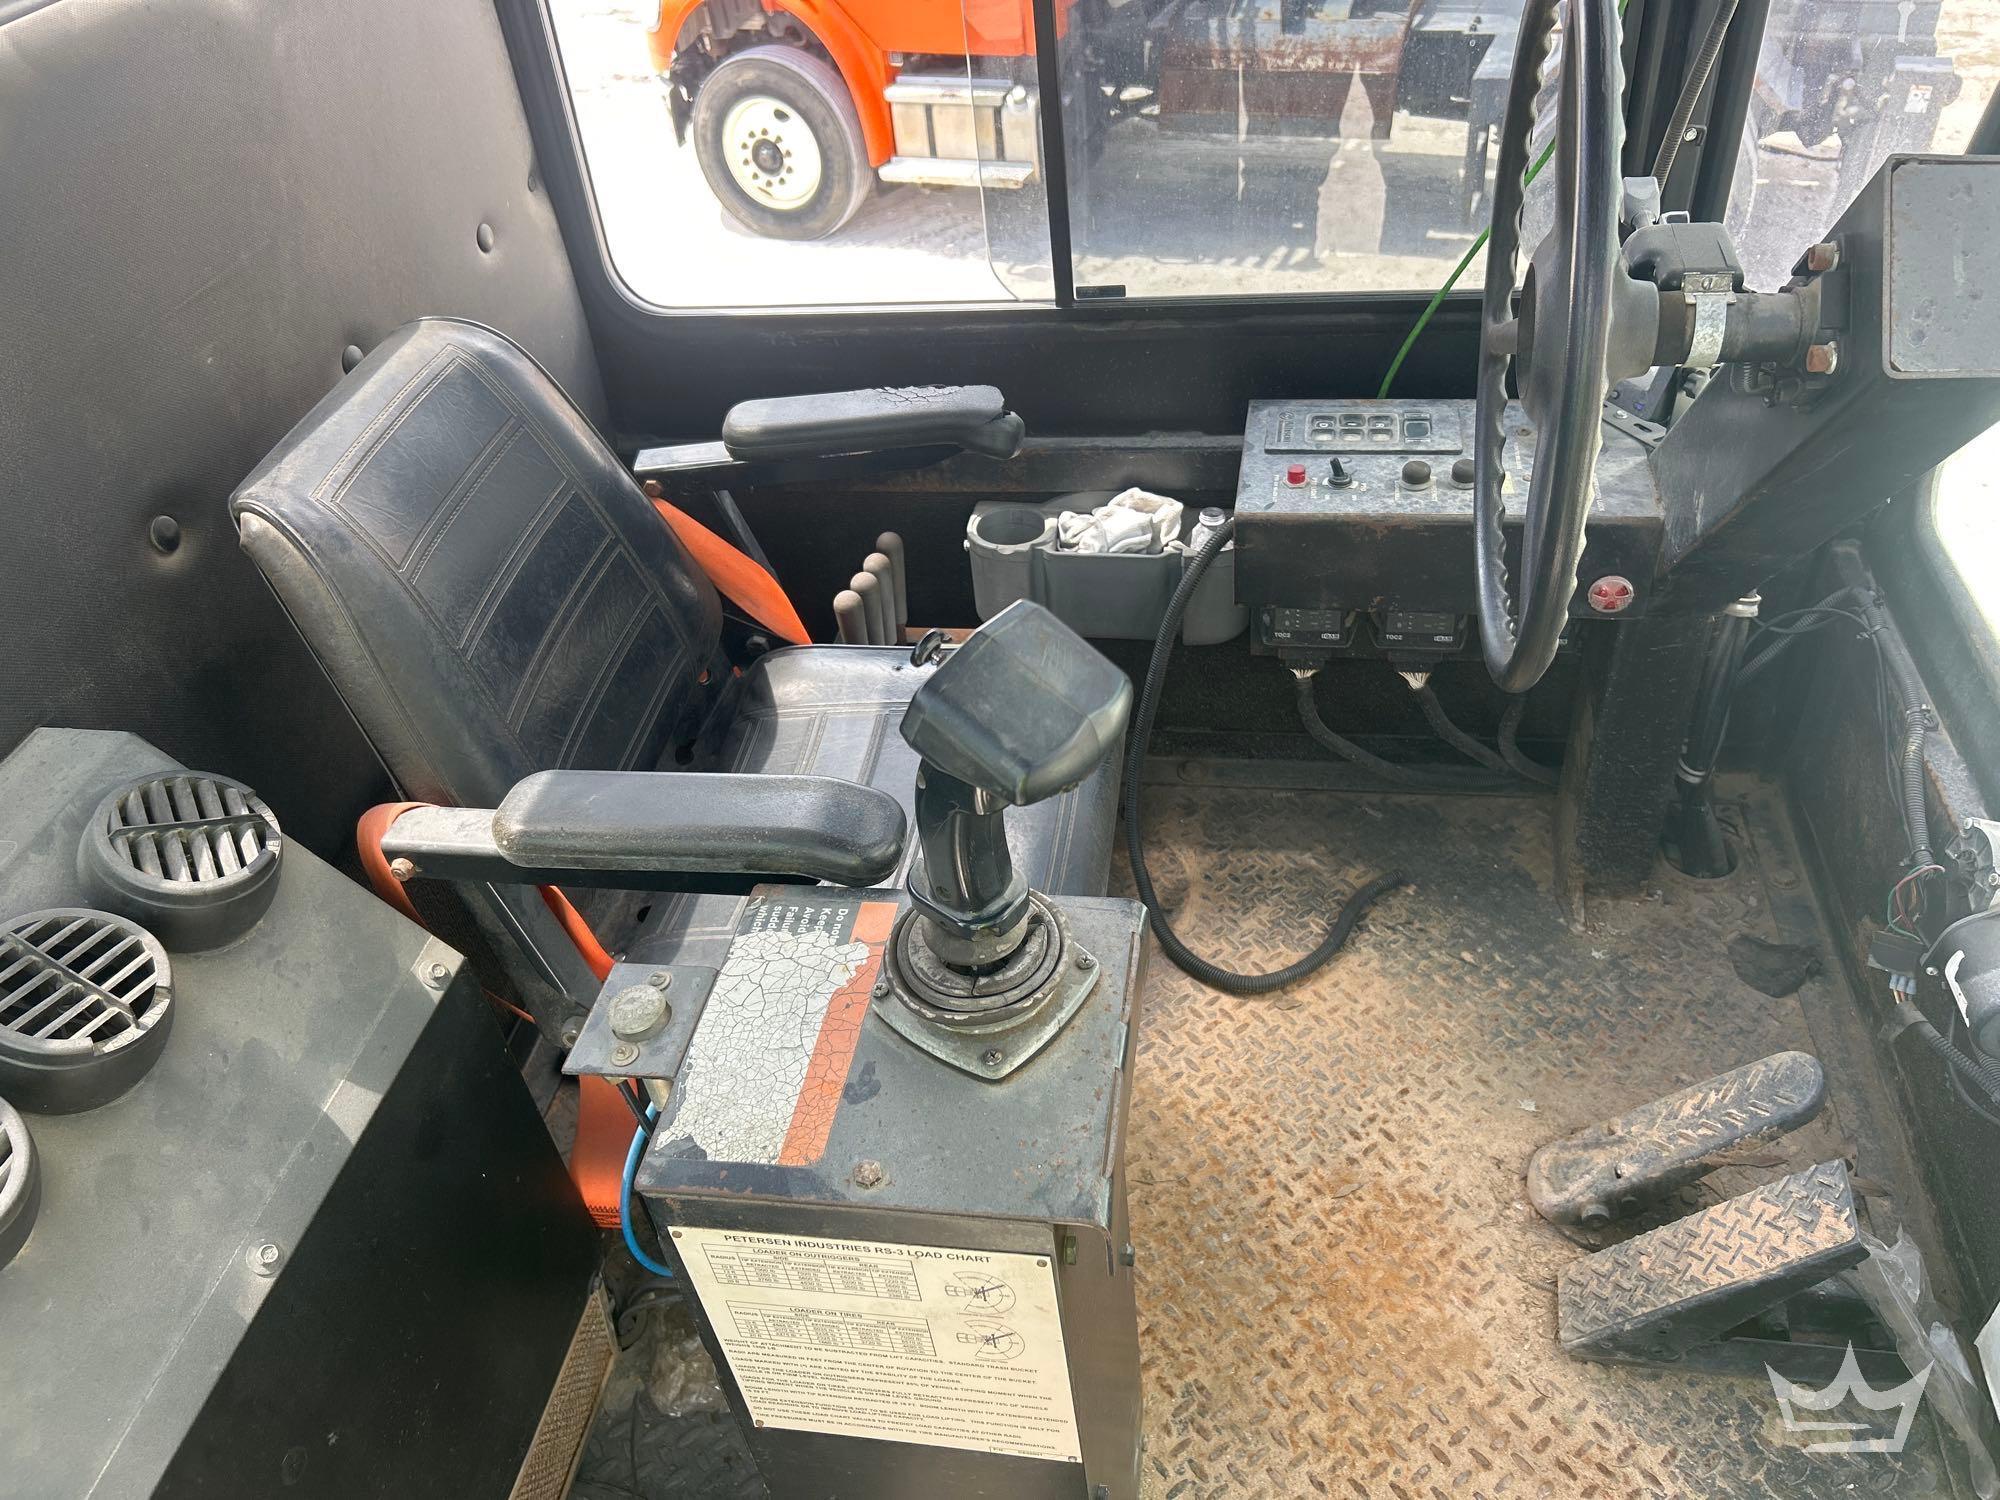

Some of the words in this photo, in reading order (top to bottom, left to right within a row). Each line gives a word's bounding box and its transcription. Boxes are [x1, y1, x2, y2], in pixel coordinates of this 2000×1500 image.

[752, 905, 769, 933] which
[797, 906, 815, 933] Avoid
[836, 908, 849, 921] Do
[723, 1234, 791, 1246] PETERSEN
[791, 1240, 871, 1252] INDUSTRIES
[872, 1246, 903, 1255] RS-3
[904, 1248, 942, 1258] LOAD
[943, 1252, 992, 1262] CHART
